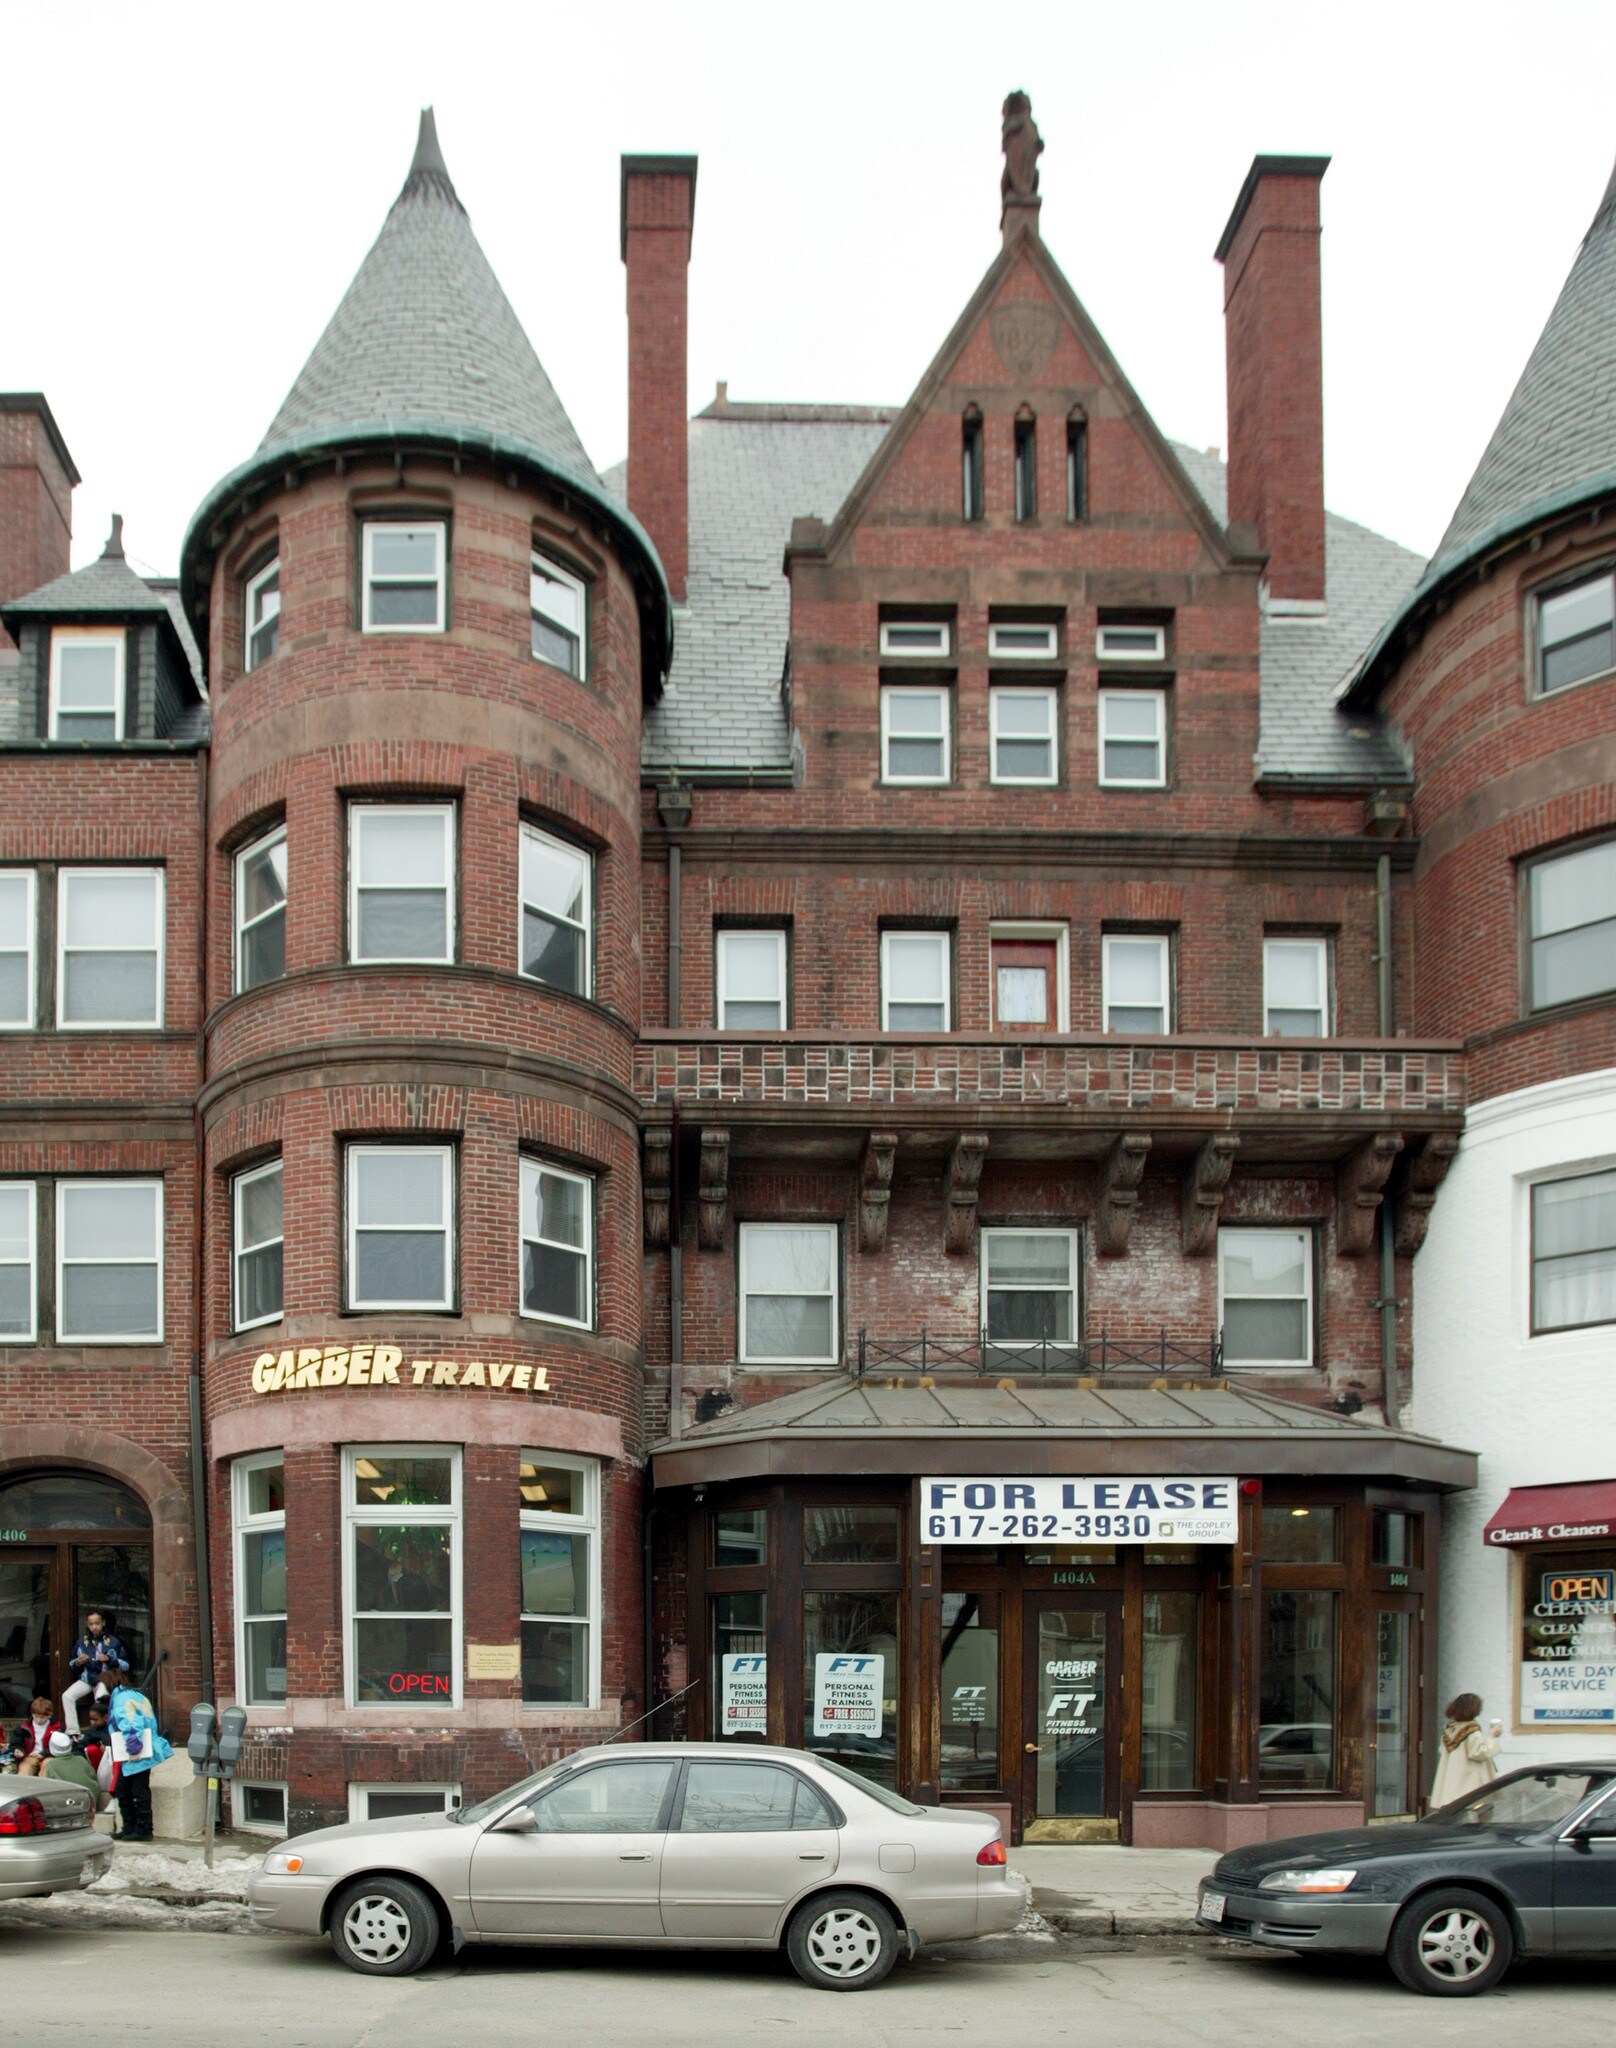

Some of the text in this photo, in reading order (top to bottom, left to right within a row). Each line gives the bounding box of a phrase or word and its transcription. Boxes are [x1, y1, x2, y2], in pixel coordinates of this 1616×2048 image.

[252, 1345, 550, 1393] GARBER TRAVEL
[931, 1484, 1228, 1510] FOR LEASE
[929, 1515, 1150, 1537] 617-262-3930
[1177, 1521, 1232, 1529] THE COPLEY
[0, 1530, 27, 1541] 406
[1489, 1523, 1609, 1542] Clean-It Cleaners
[1053, 1571, 1096, 1584] 1404A
[1550, 1577, 1608, 1601] OPEN
[1533, 1601, 1616, 1617] CLEAN-I
[1570, 1635, 1583, 1645] &
[732, 1657, 767, 1672] FT
[828, 1658, 875, 1673] FT
[1046, 1661, 1097, 1675] GARBER
[1532, 1666, 1616, 1678] SAME DAY
[389, 1673, 449, 1694] OPEN
[824, 1683, 875, 1691] PERSONAL
[1542, 1680, 1606, 1691] SERVICE
[953, 1686, 987, 1698] FT
[1046, 1694, 1097, 1716] FT
[834, 1708, 849, 1719] FREE
